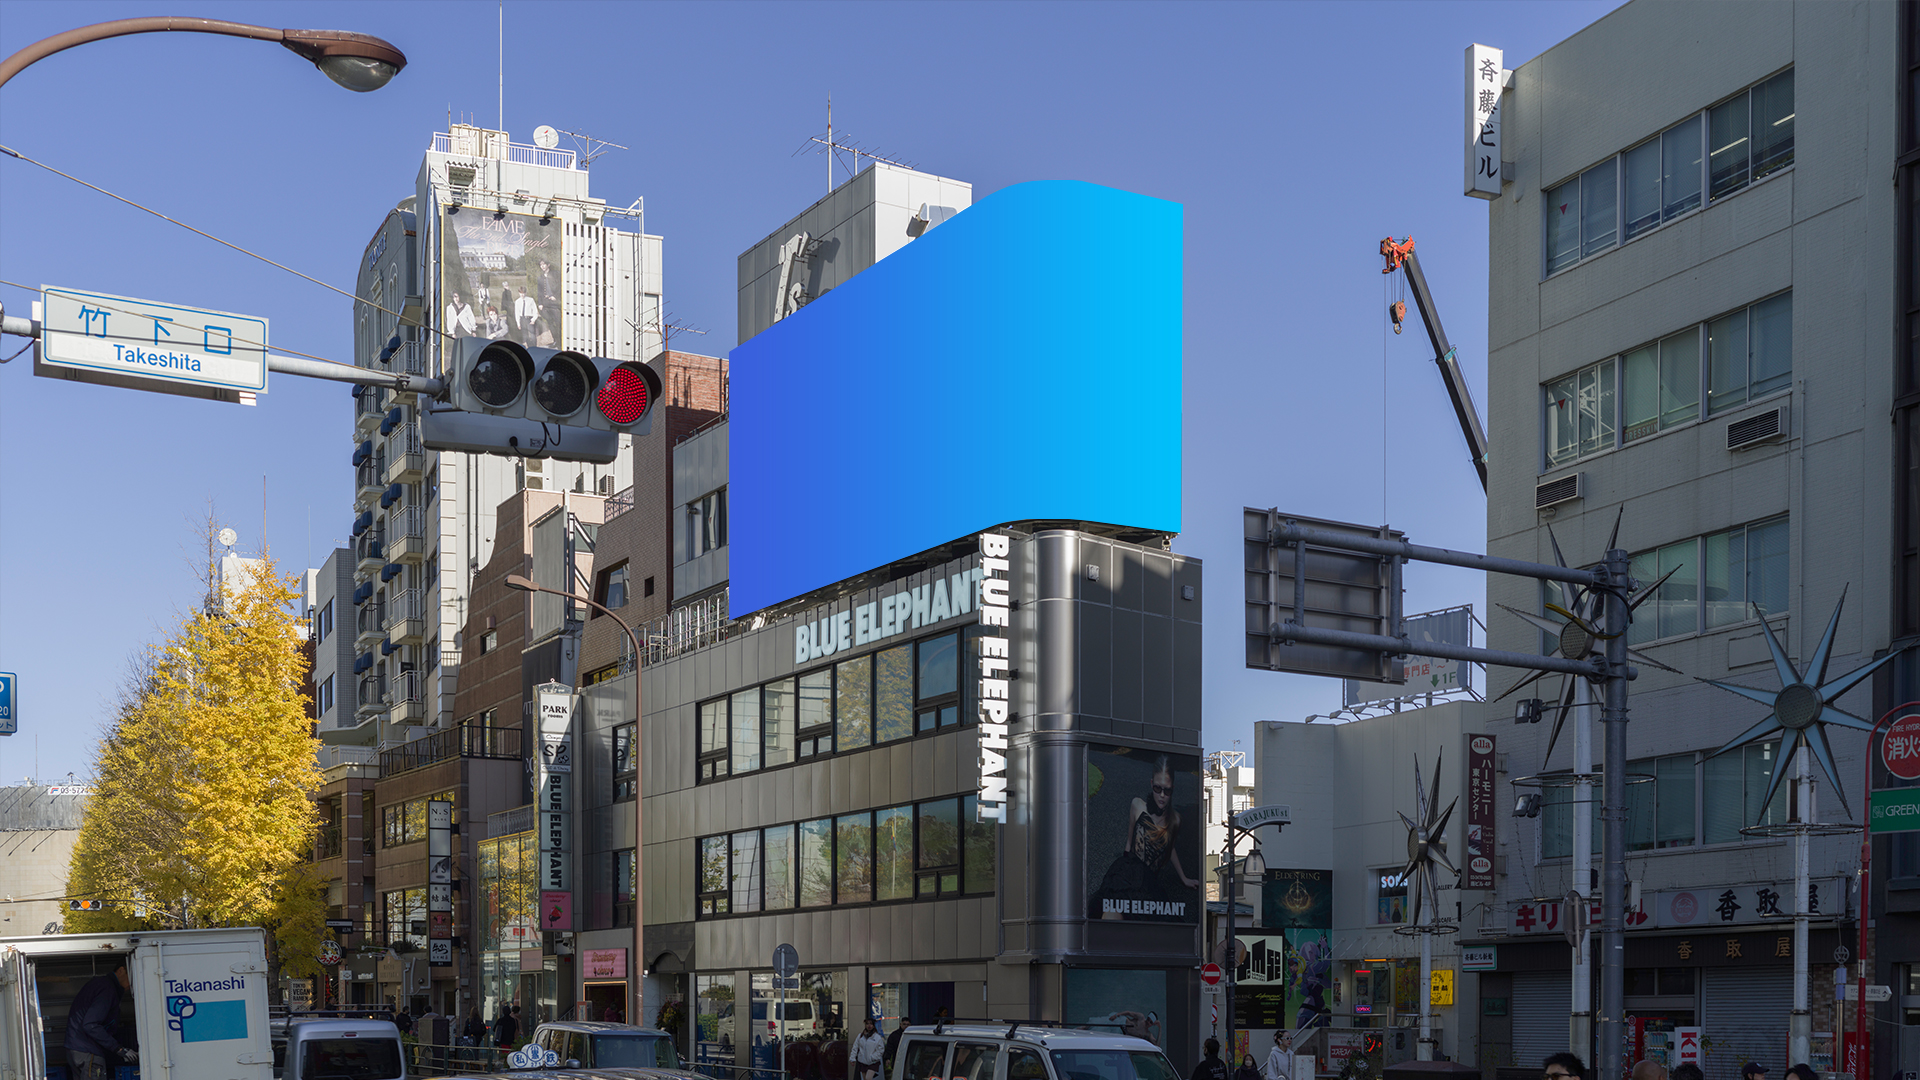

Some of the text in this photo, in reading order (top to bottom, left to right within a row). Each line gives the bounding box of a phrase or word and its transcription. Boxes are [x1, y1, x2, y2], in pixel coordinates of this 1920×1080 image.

[1478, 58, 1499, 179] 斉藤ビル
[482, 216, 526, 235] FAME
[78, 305, 232, 355] 竹下口
[113, 343, 202, 373] Takeshita
[796, 567, 984, 664] BLUE ELEPHANT
[977, 533, 1010, 825] BLUE ELEPHANT
[1443, 672, 1456, 684] 1F
[543, 705, 568, 714] PARK
[1892, 725, 1904, 733] FIRE
[1473, 740, 1491, 749] alla
[1888, 735, 1920, 760] 消火
[550, 775, 562, 811] BLUE
[1472, 768, 1481, 820] 東京センター
[1482, 759, 1492, 815] ハーモニー
[1243, 808, 1280, 826] HARAJUKU
[1885, 804, 1920, 817] GREEN
[550, 814, 562, 888] ELEPHANT
[1473, 859, 1489, 868] alla
[1275, 871, 1320, 881] ELDEN RING
[1102, 898, 1186, 916] BLUE ELEPHANT
[1677, 936, 1792, 960] 香取屋
[165, 976, 245, 993] Takanashi
[1681, 1032, 1697, 1065] KI
